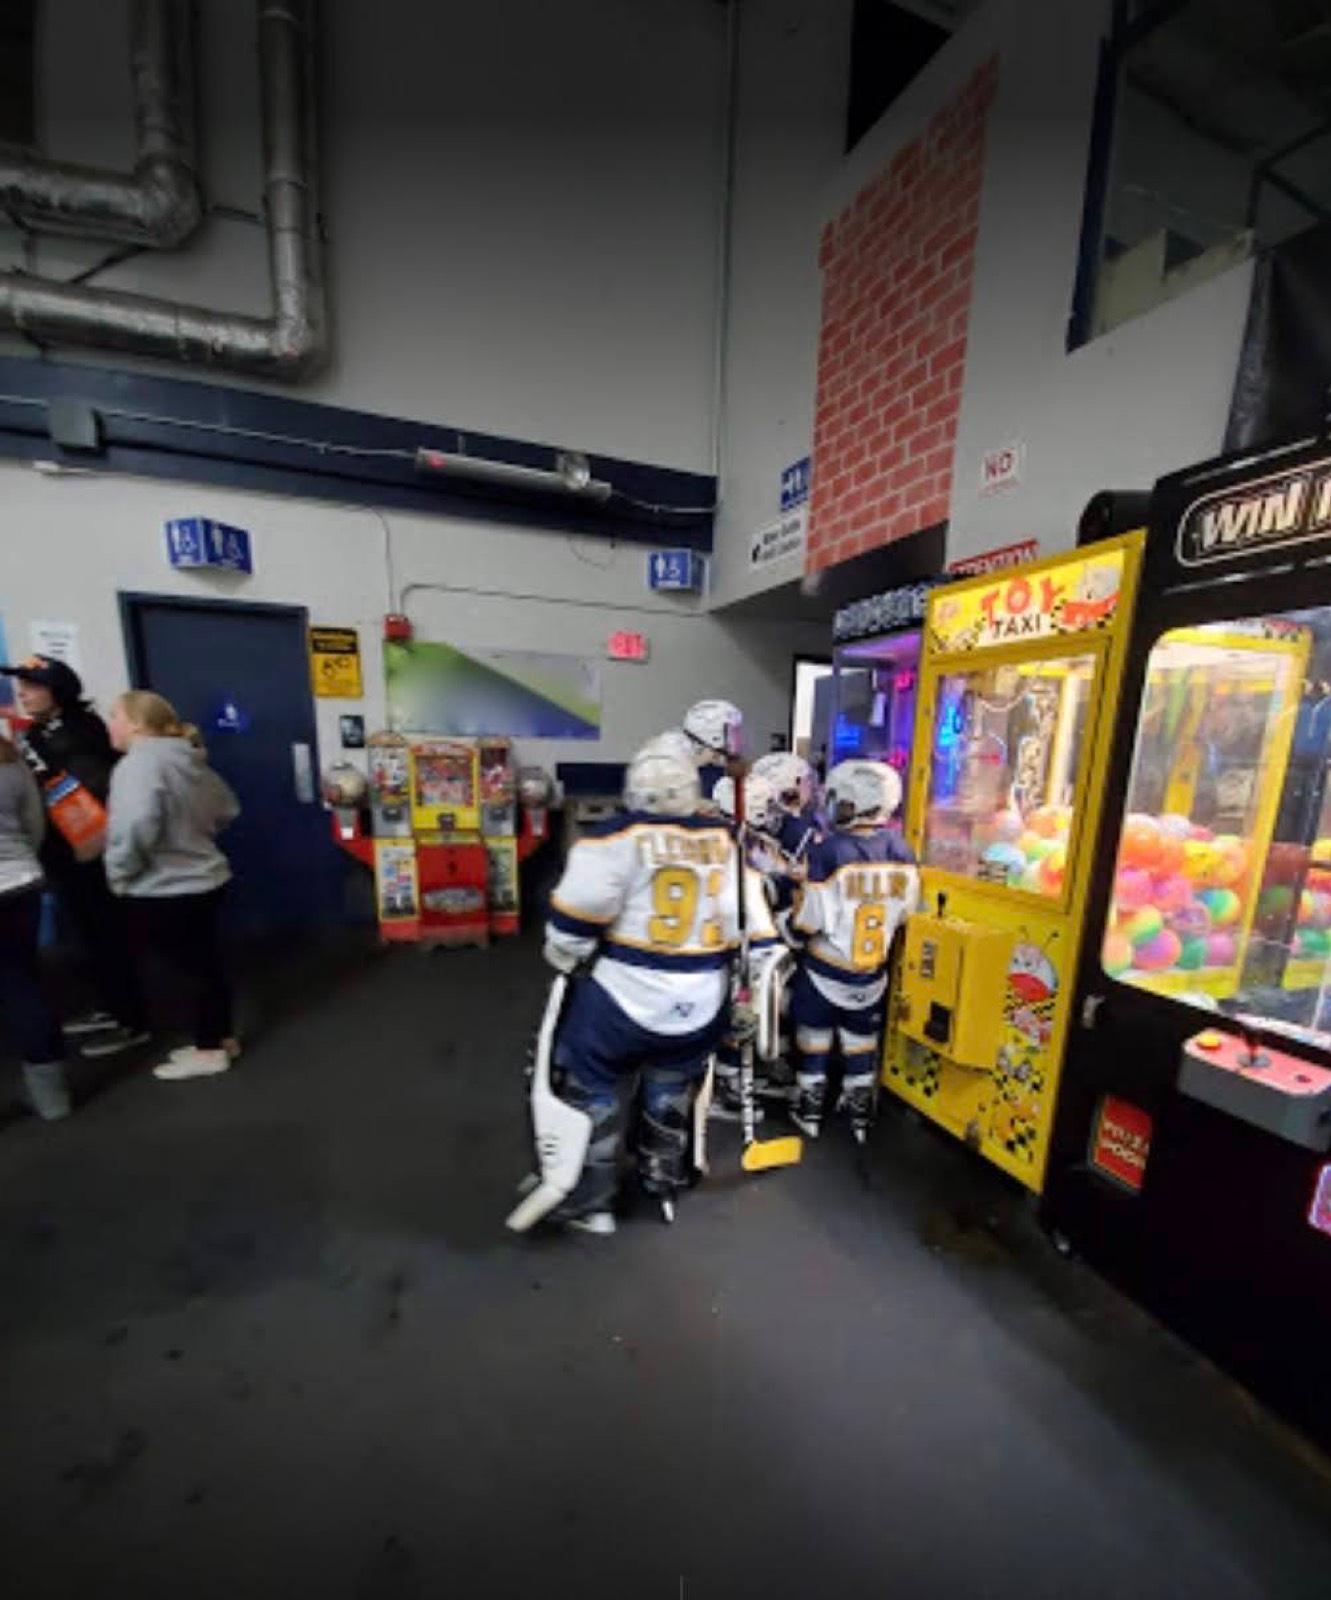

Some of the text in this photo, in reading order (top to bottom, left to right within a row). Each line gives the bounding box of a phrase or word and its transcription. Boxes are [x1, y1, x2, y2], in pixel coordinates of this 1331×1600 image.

[985, 450, 1014, 480] NO
[1199, 477, 1310, 551] WIN
[981, 576, 1066, 630] TOY
[994, 613, 1041, 639] TAXI
